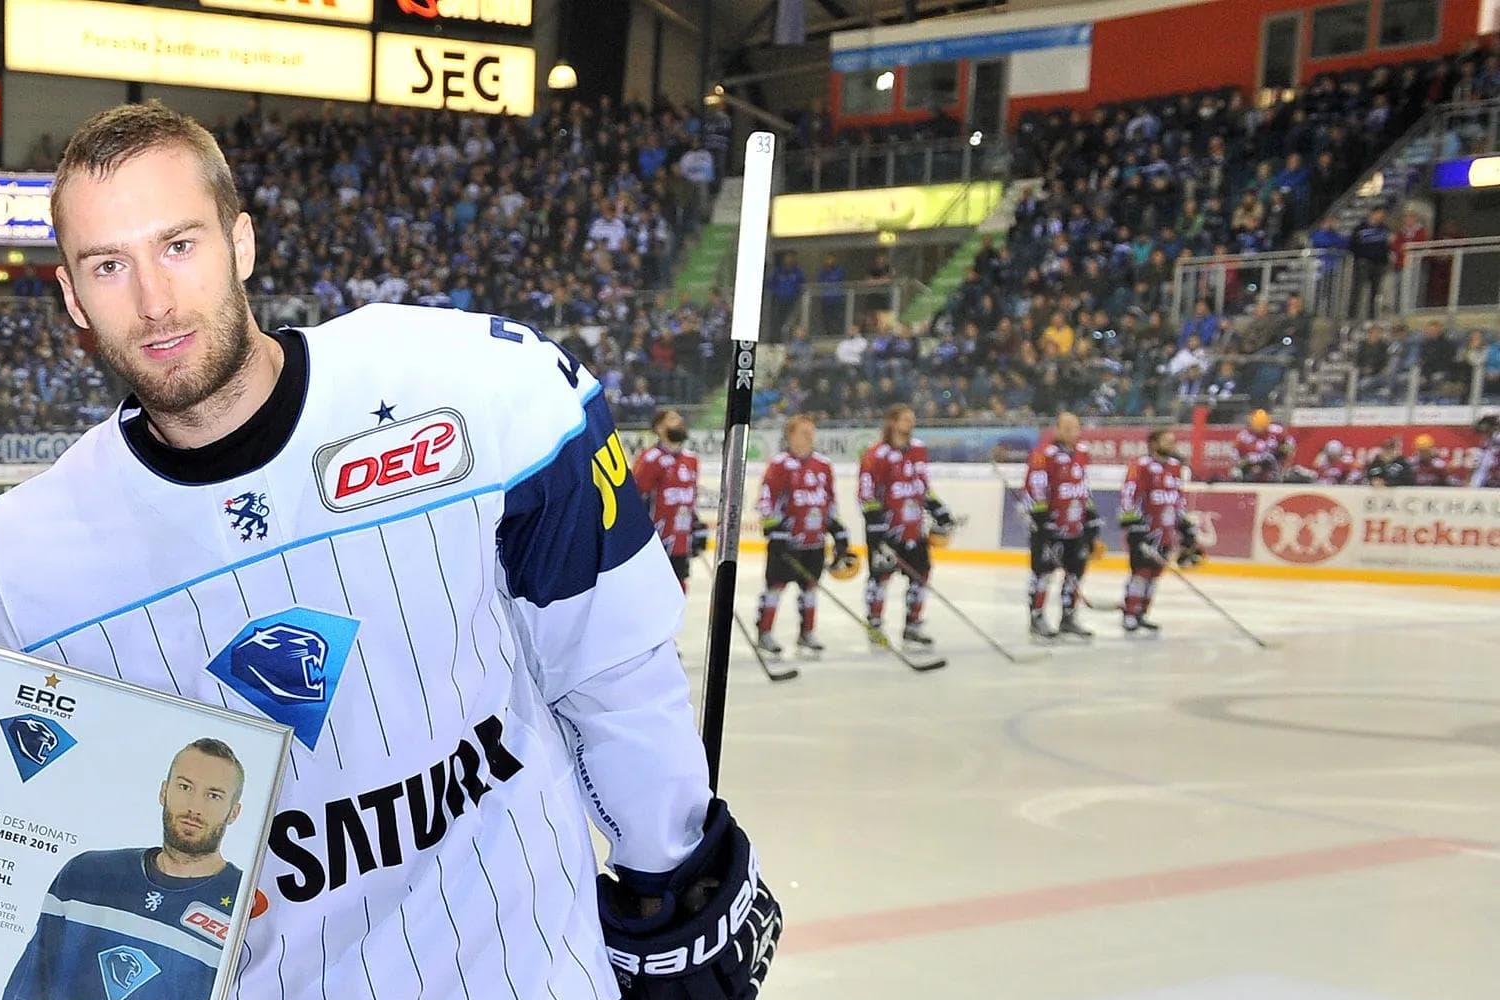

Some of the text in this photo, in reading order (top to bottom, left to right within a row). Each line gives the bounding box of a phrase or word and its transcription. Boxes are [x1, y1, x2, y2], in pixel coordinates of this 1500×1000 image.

[411, 48, 500, 101] SEG
[335, 422, 455, 499] DEL
[15, 700, 72, 720] INGOLSTADT
[17, 684, 76, 713] ERC
[2, 815, 25, 830] DES
[28, 822, 78, 845] MONATS
[29, 838, 59, 854] 2016
[0, 901, 18, 912] VON
